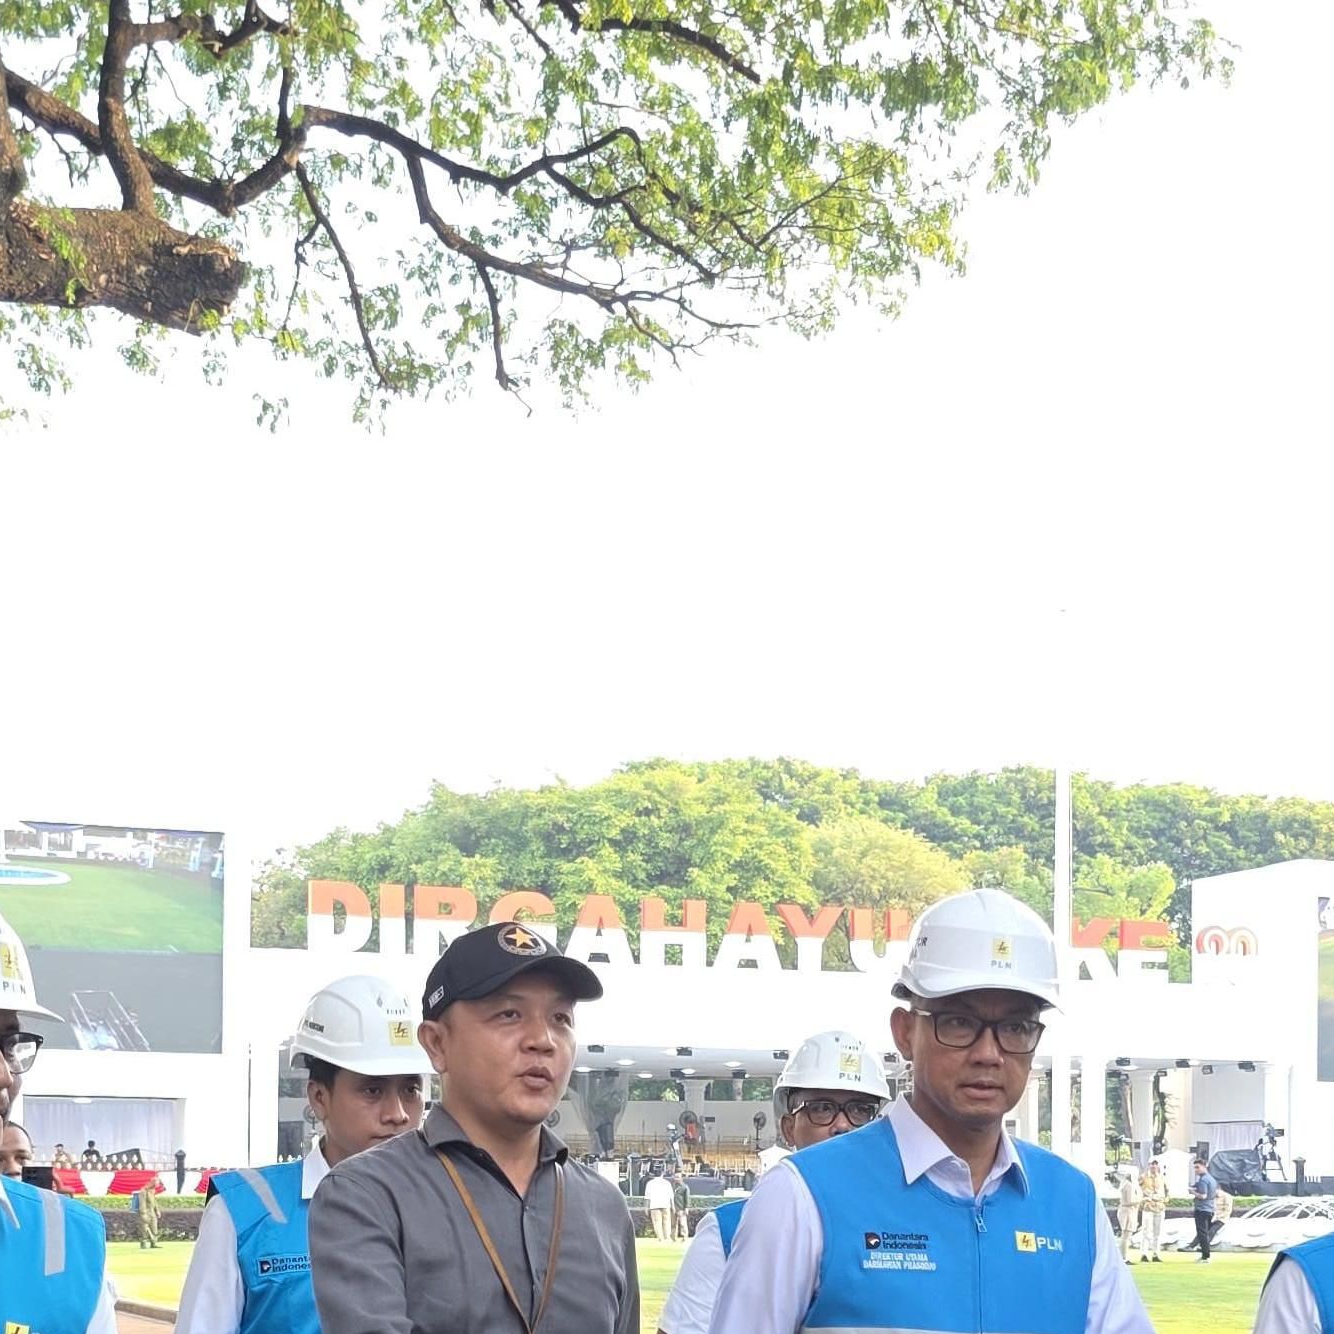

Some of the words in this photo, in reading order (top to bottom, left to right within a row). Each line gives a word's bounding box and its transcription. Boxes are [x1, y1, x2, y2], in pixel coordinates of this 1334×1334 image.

[990, 959, 1012, 970] PLN
[838, 1072, 862, 1083] PLN
[881, 1232, 929, 1241] Danantara
[882, 1241, 927, 1250] Indonesia
[1036, 1236, 1064, 1253] PLN
[271, 1255, 311, 1265] Danant
